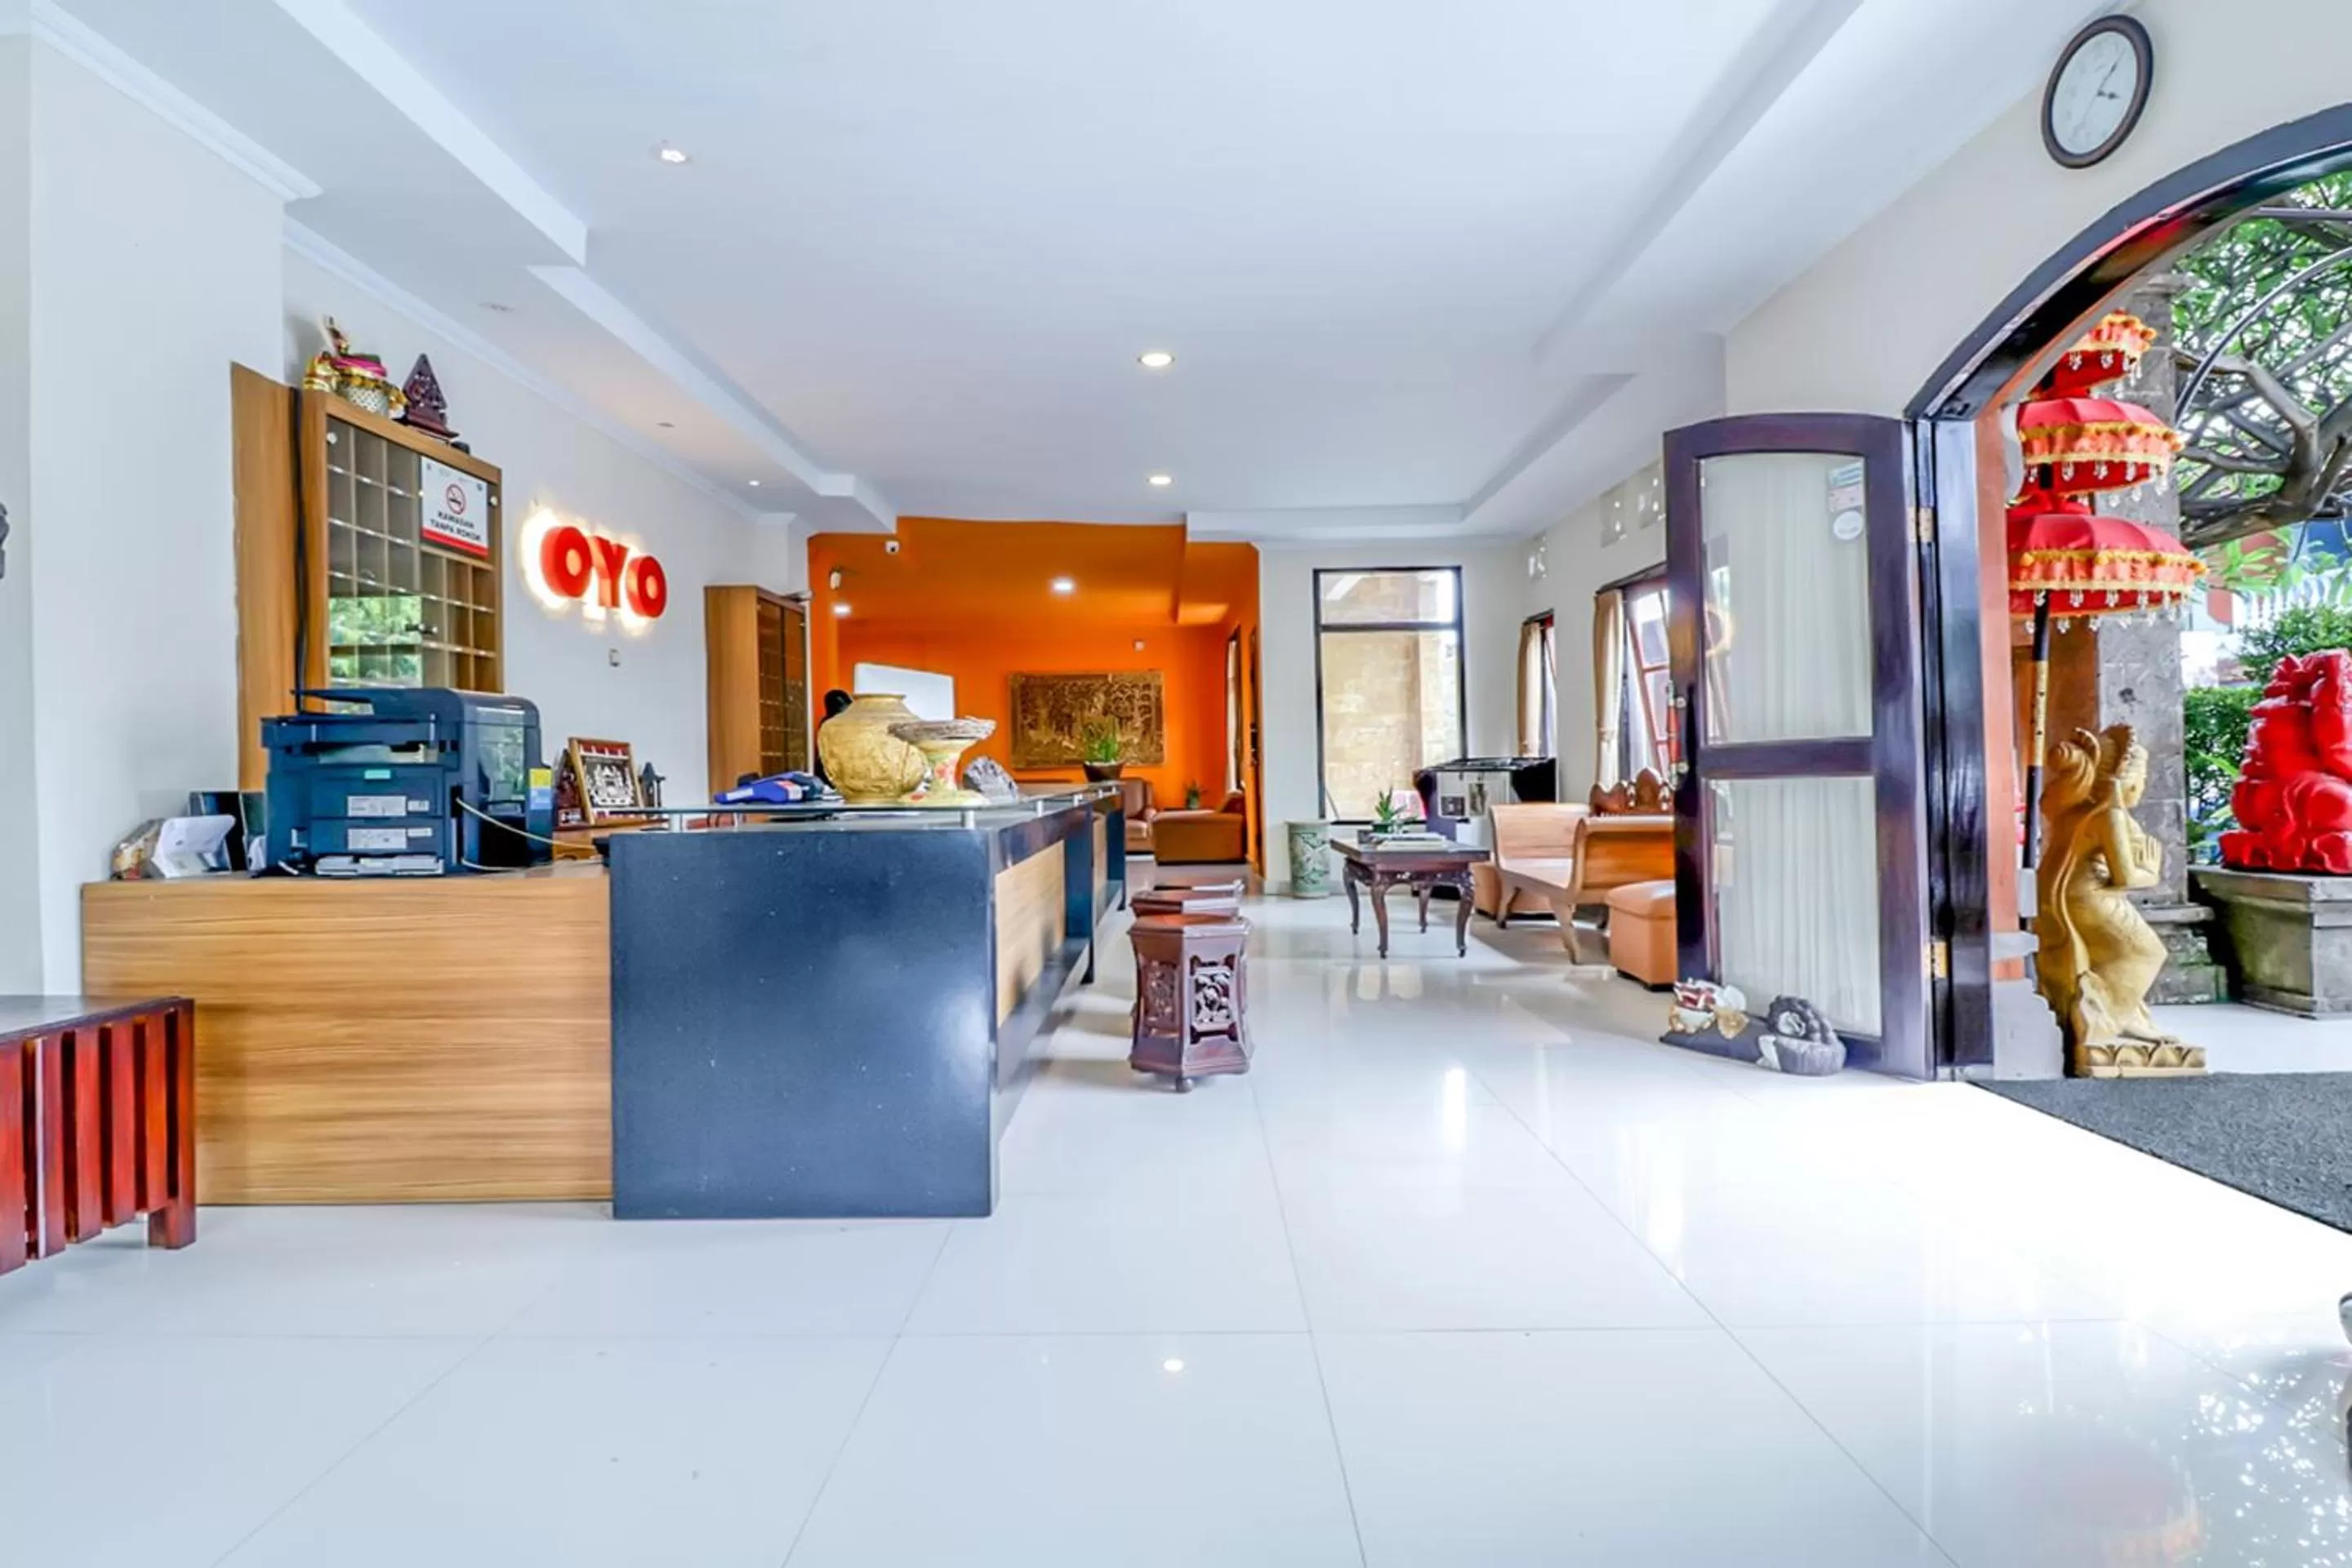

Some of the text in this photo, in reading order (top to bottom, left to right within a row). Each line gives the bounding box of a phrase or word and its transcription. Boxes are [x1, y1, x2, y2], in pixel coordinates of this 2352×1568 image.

[430, 519, 481, 540] TANPA ROKOK
[438, 511, 474, 528] KAWASAN
[540, 526, 667, 619] OYO
